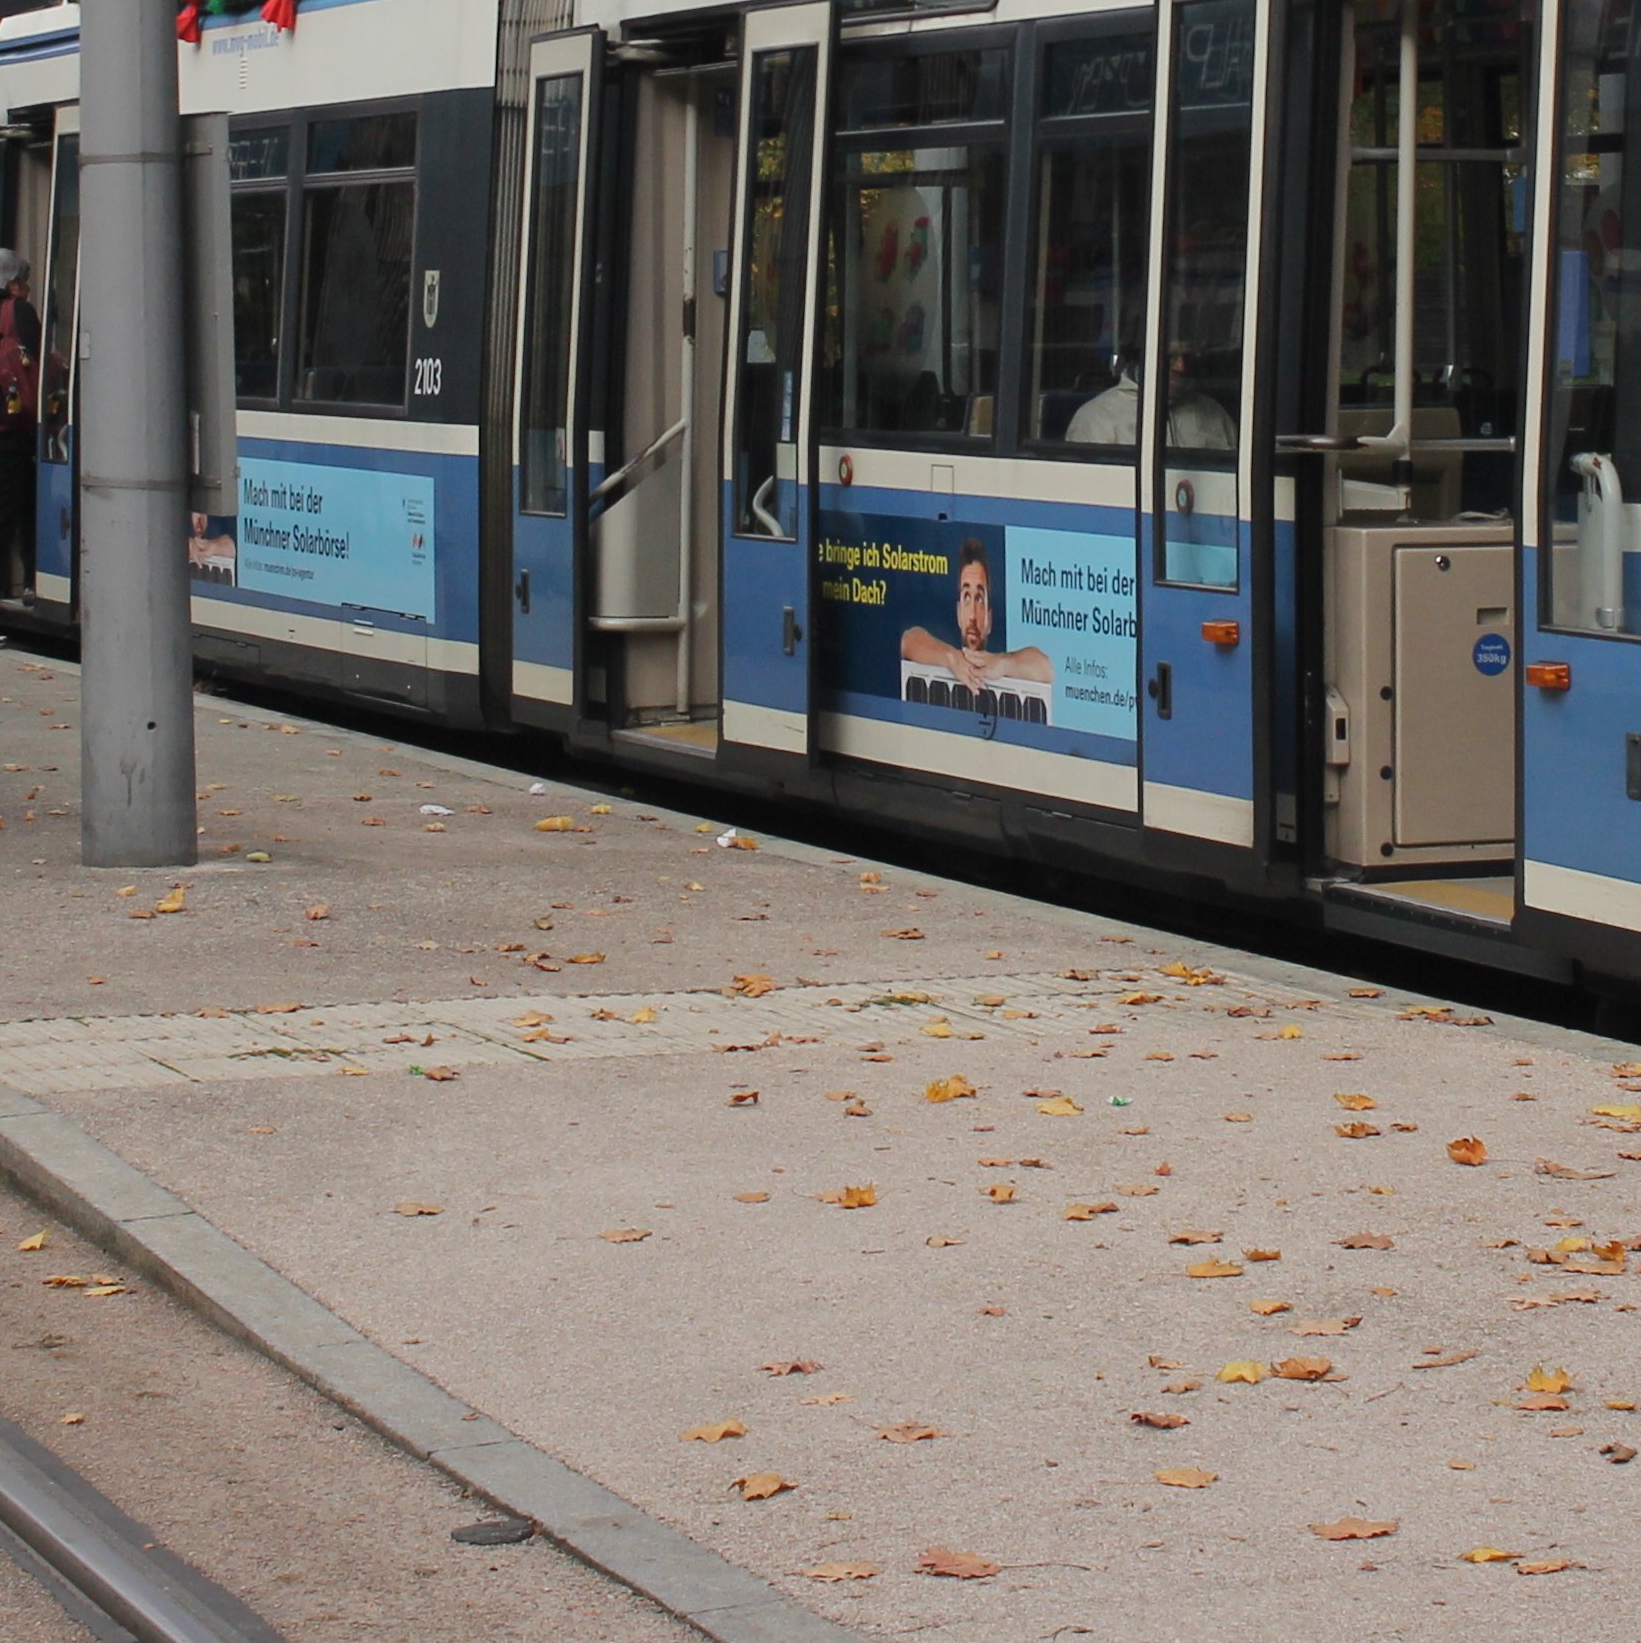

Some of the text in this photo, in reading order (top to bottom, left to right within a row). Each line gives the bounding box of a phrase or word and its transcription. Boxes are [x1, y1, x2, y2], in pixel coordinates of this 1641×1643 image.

[414, 357, 442, 395] 2103
[244, 478, 323, 514] Mach mit bei der
[244, 517, 350, 559] Münchner Solarbörse!
[825, 538, 861, 570] bringe
[863, 541, 880, 567] ich
[882, 543, 949, 575] Solarstrom
[852, 577, 887, 605] Dach?
[1021, 558, 1135, 596] Mach mit bei der
[1021, 598, 1089, 632] Münchner
[1065, 657, 1108, 679] Alle Infos:
[1065, 685, 1136, 711] muenchen.de/p
